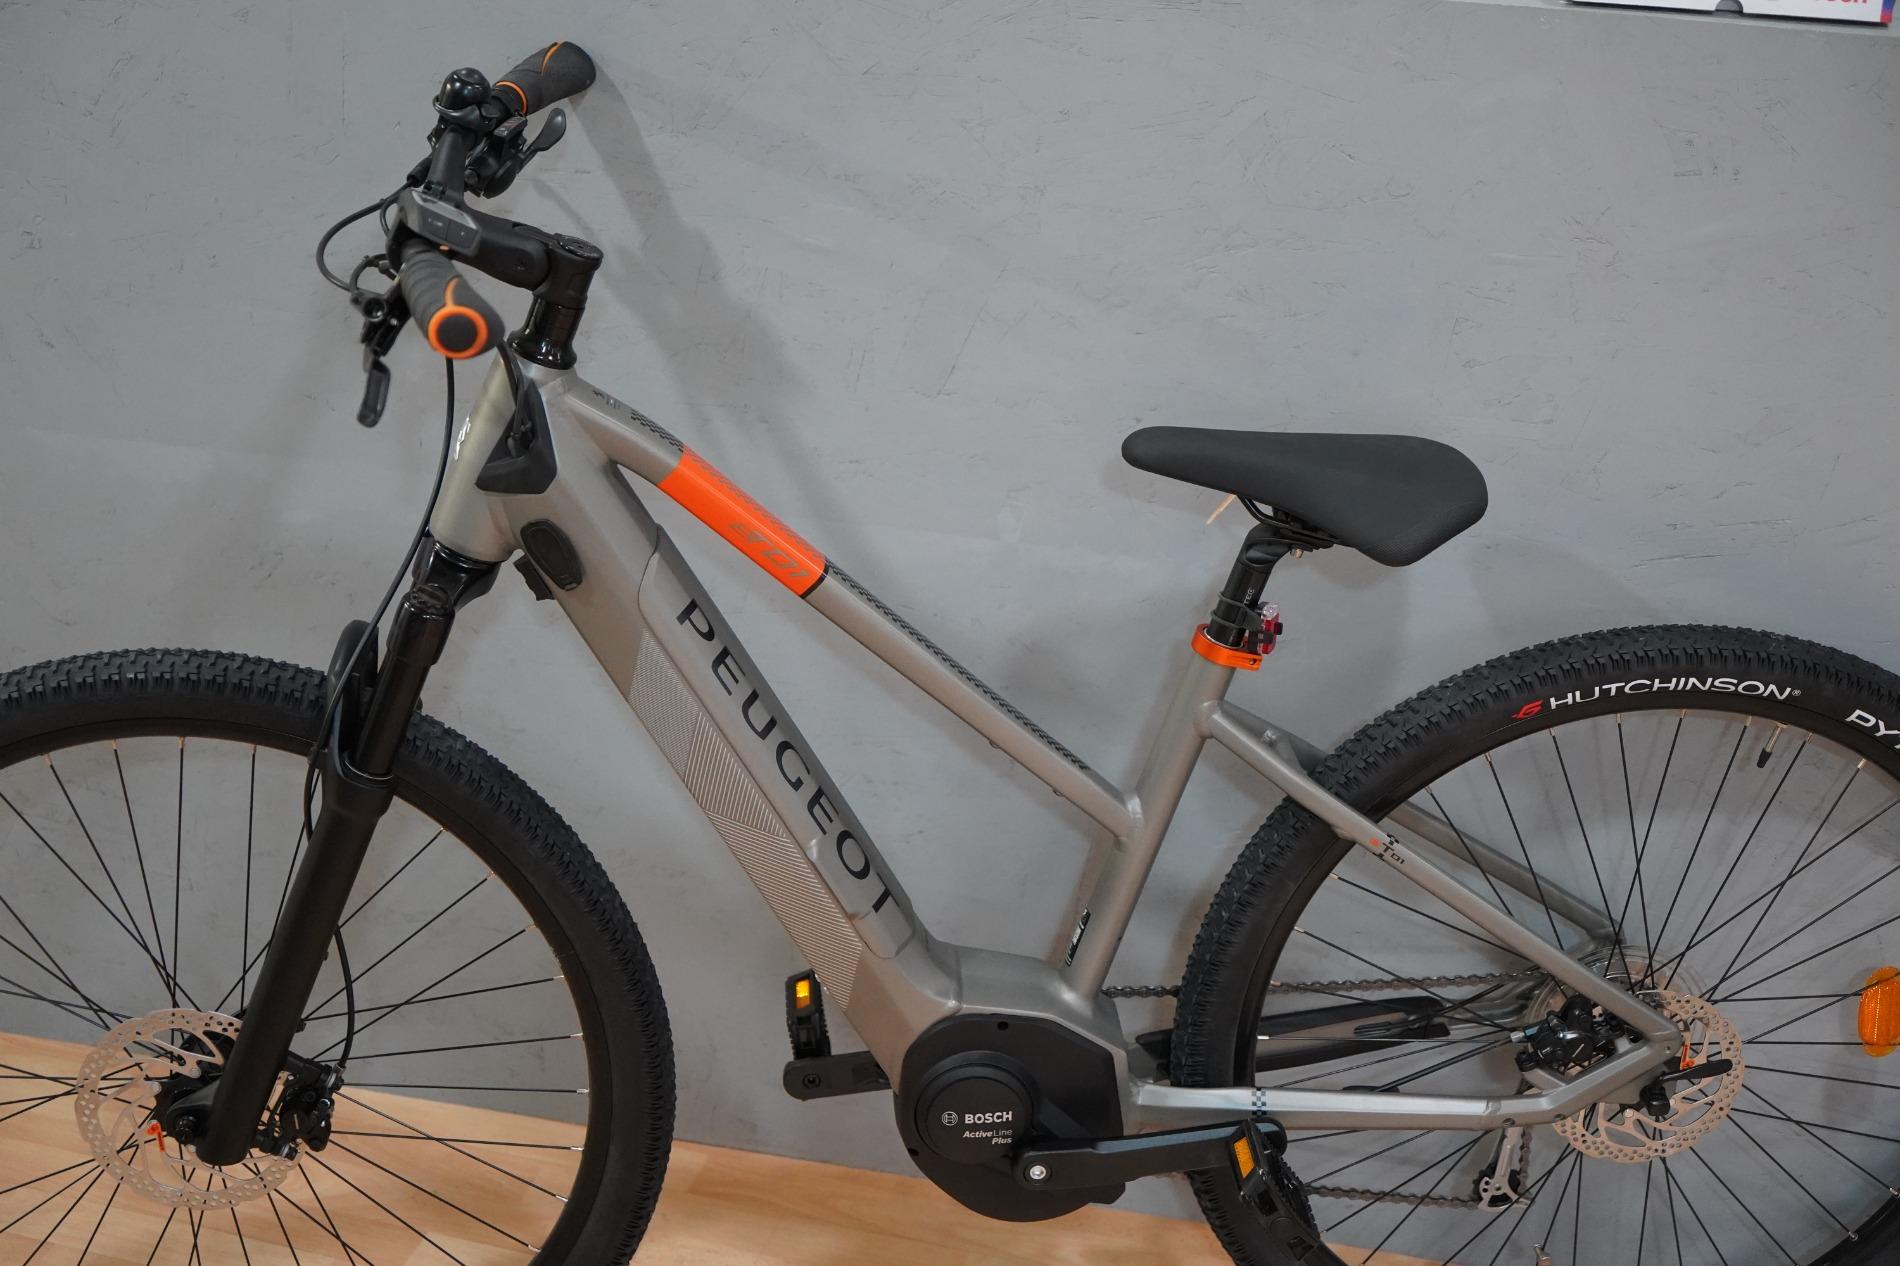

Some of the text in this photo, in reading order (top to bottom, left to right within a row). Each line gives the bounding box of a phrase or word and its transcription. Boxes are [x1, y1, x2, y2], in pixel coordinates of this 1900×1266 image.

[1845, 708, 1900, 749] PY
[676, 599, 900, 913] PEUGEOT
[964, 1111, 1013, 1124] BOSCH
[991, 1137, 1012, 1145] Plus
